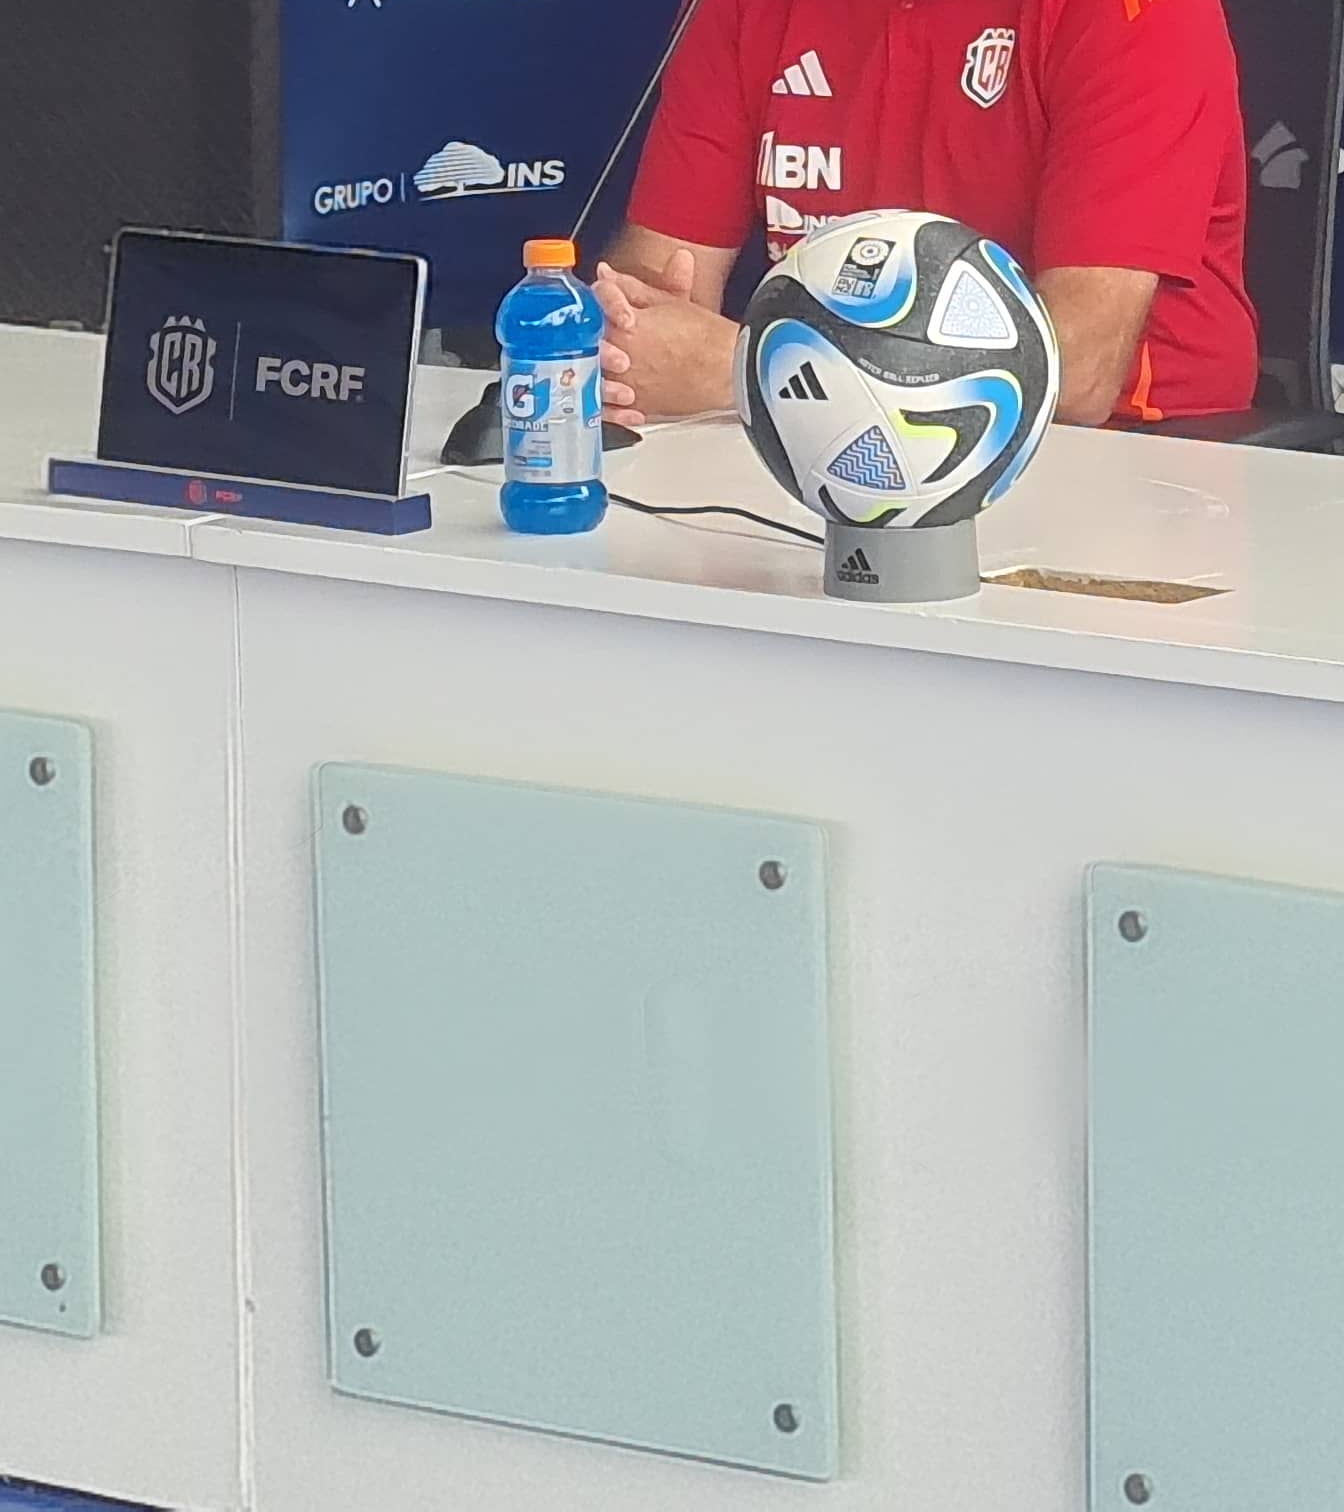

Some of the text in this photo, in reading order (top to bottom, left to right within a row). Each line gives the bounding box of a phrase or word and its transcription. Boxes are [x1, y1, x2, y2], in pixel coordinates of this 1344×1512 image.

[315, 160, 564, 213] GRUPO INS
[775, 145, 841, 189] BN
[506, 374, 535, 418] G
